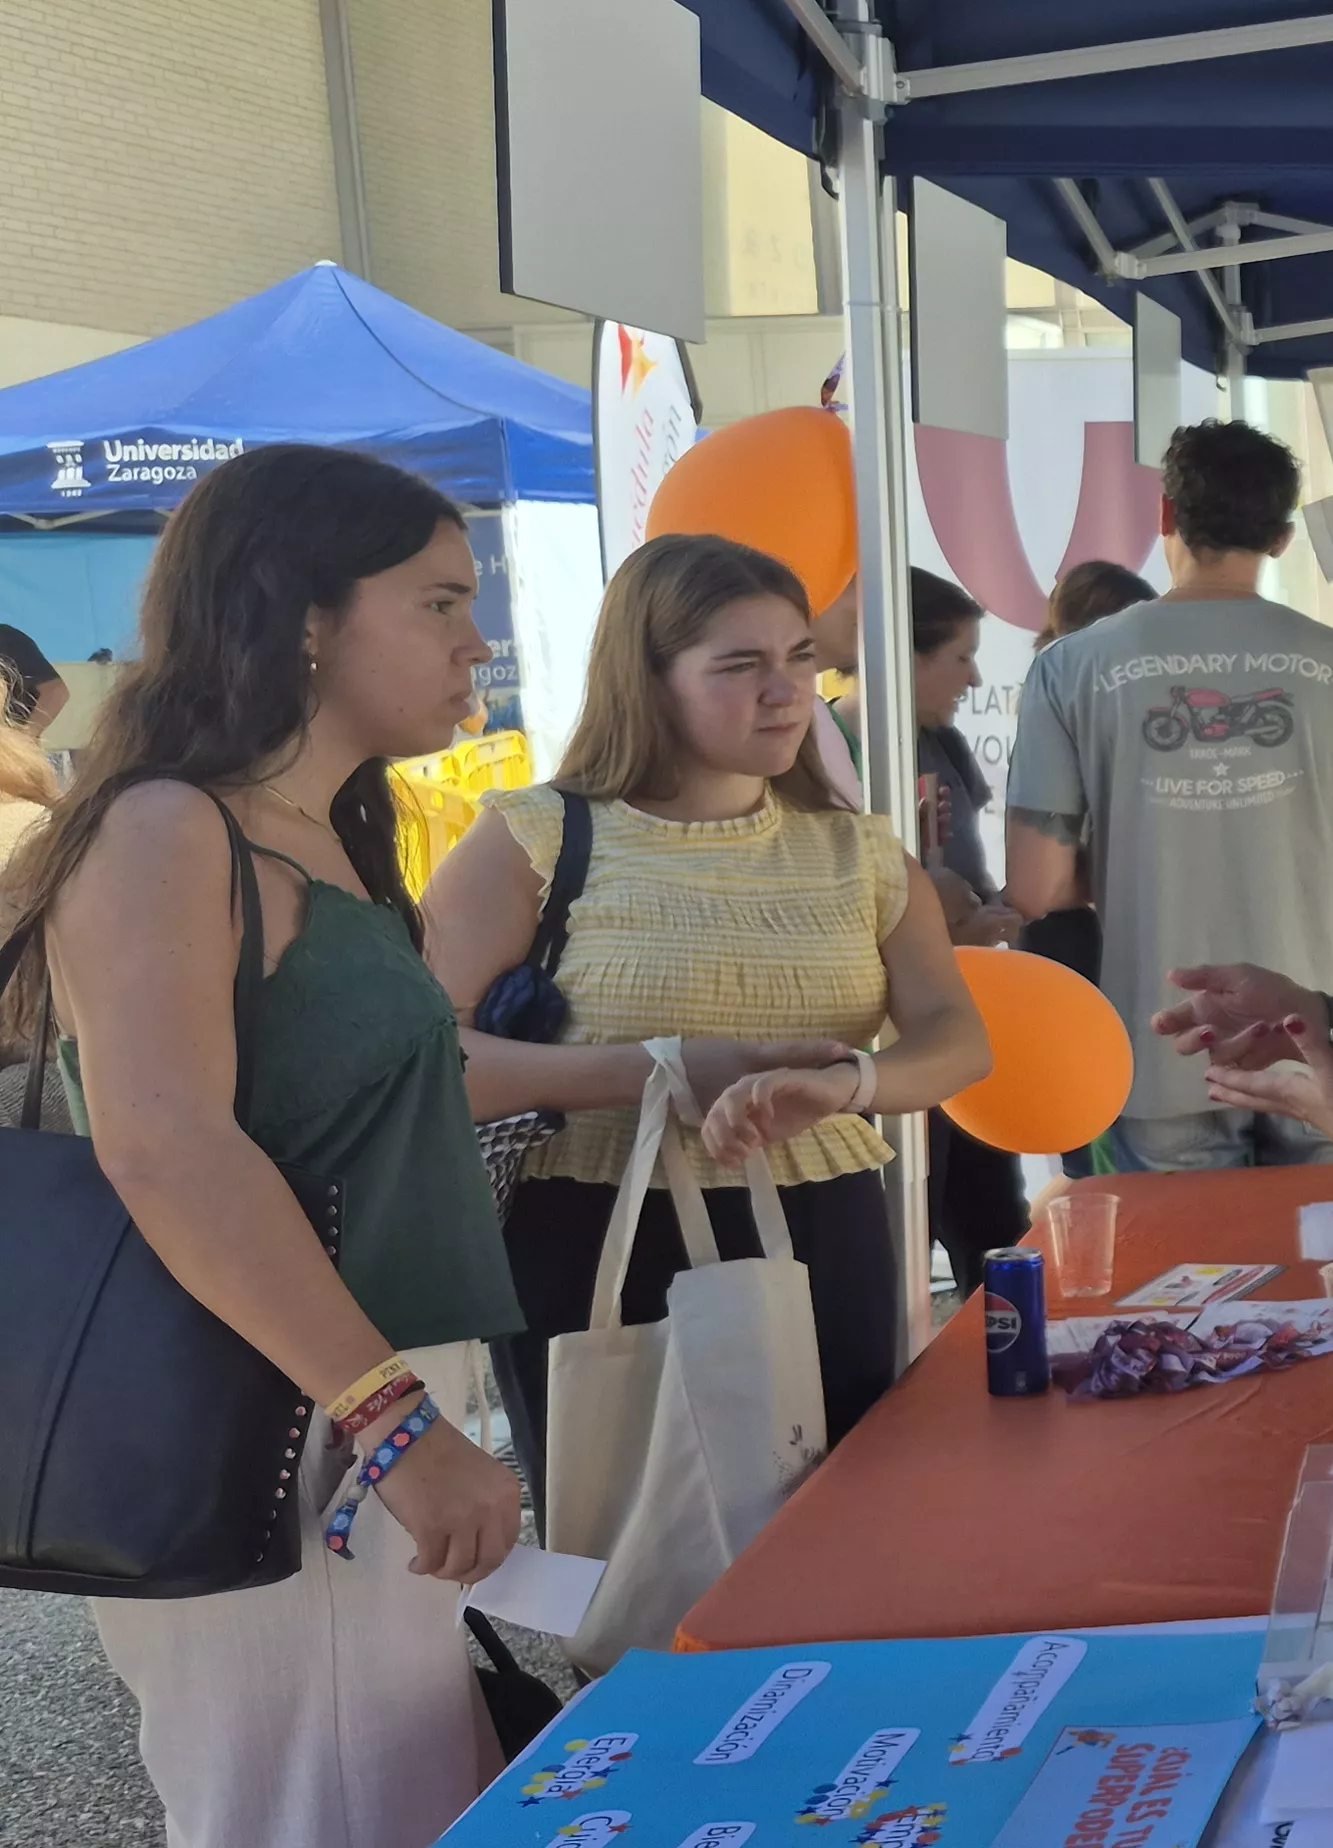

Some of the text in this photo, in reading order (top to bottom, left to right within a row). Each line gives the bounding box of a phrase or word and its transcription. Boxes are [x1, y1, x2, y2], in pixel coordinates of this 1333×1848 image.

[103, 438, 244, 462] Universidad
[106, 464, 198, 485] Zaragoza
[1100, 653, 1333, 693] LEGENDARY MOTOR
[1155, 770, 1286, 796] LIVE FOR SPEED
[705, 1667, 814, 1762] Dinamización
[1065, 1743, 1157, 1848] SUPERPODE
